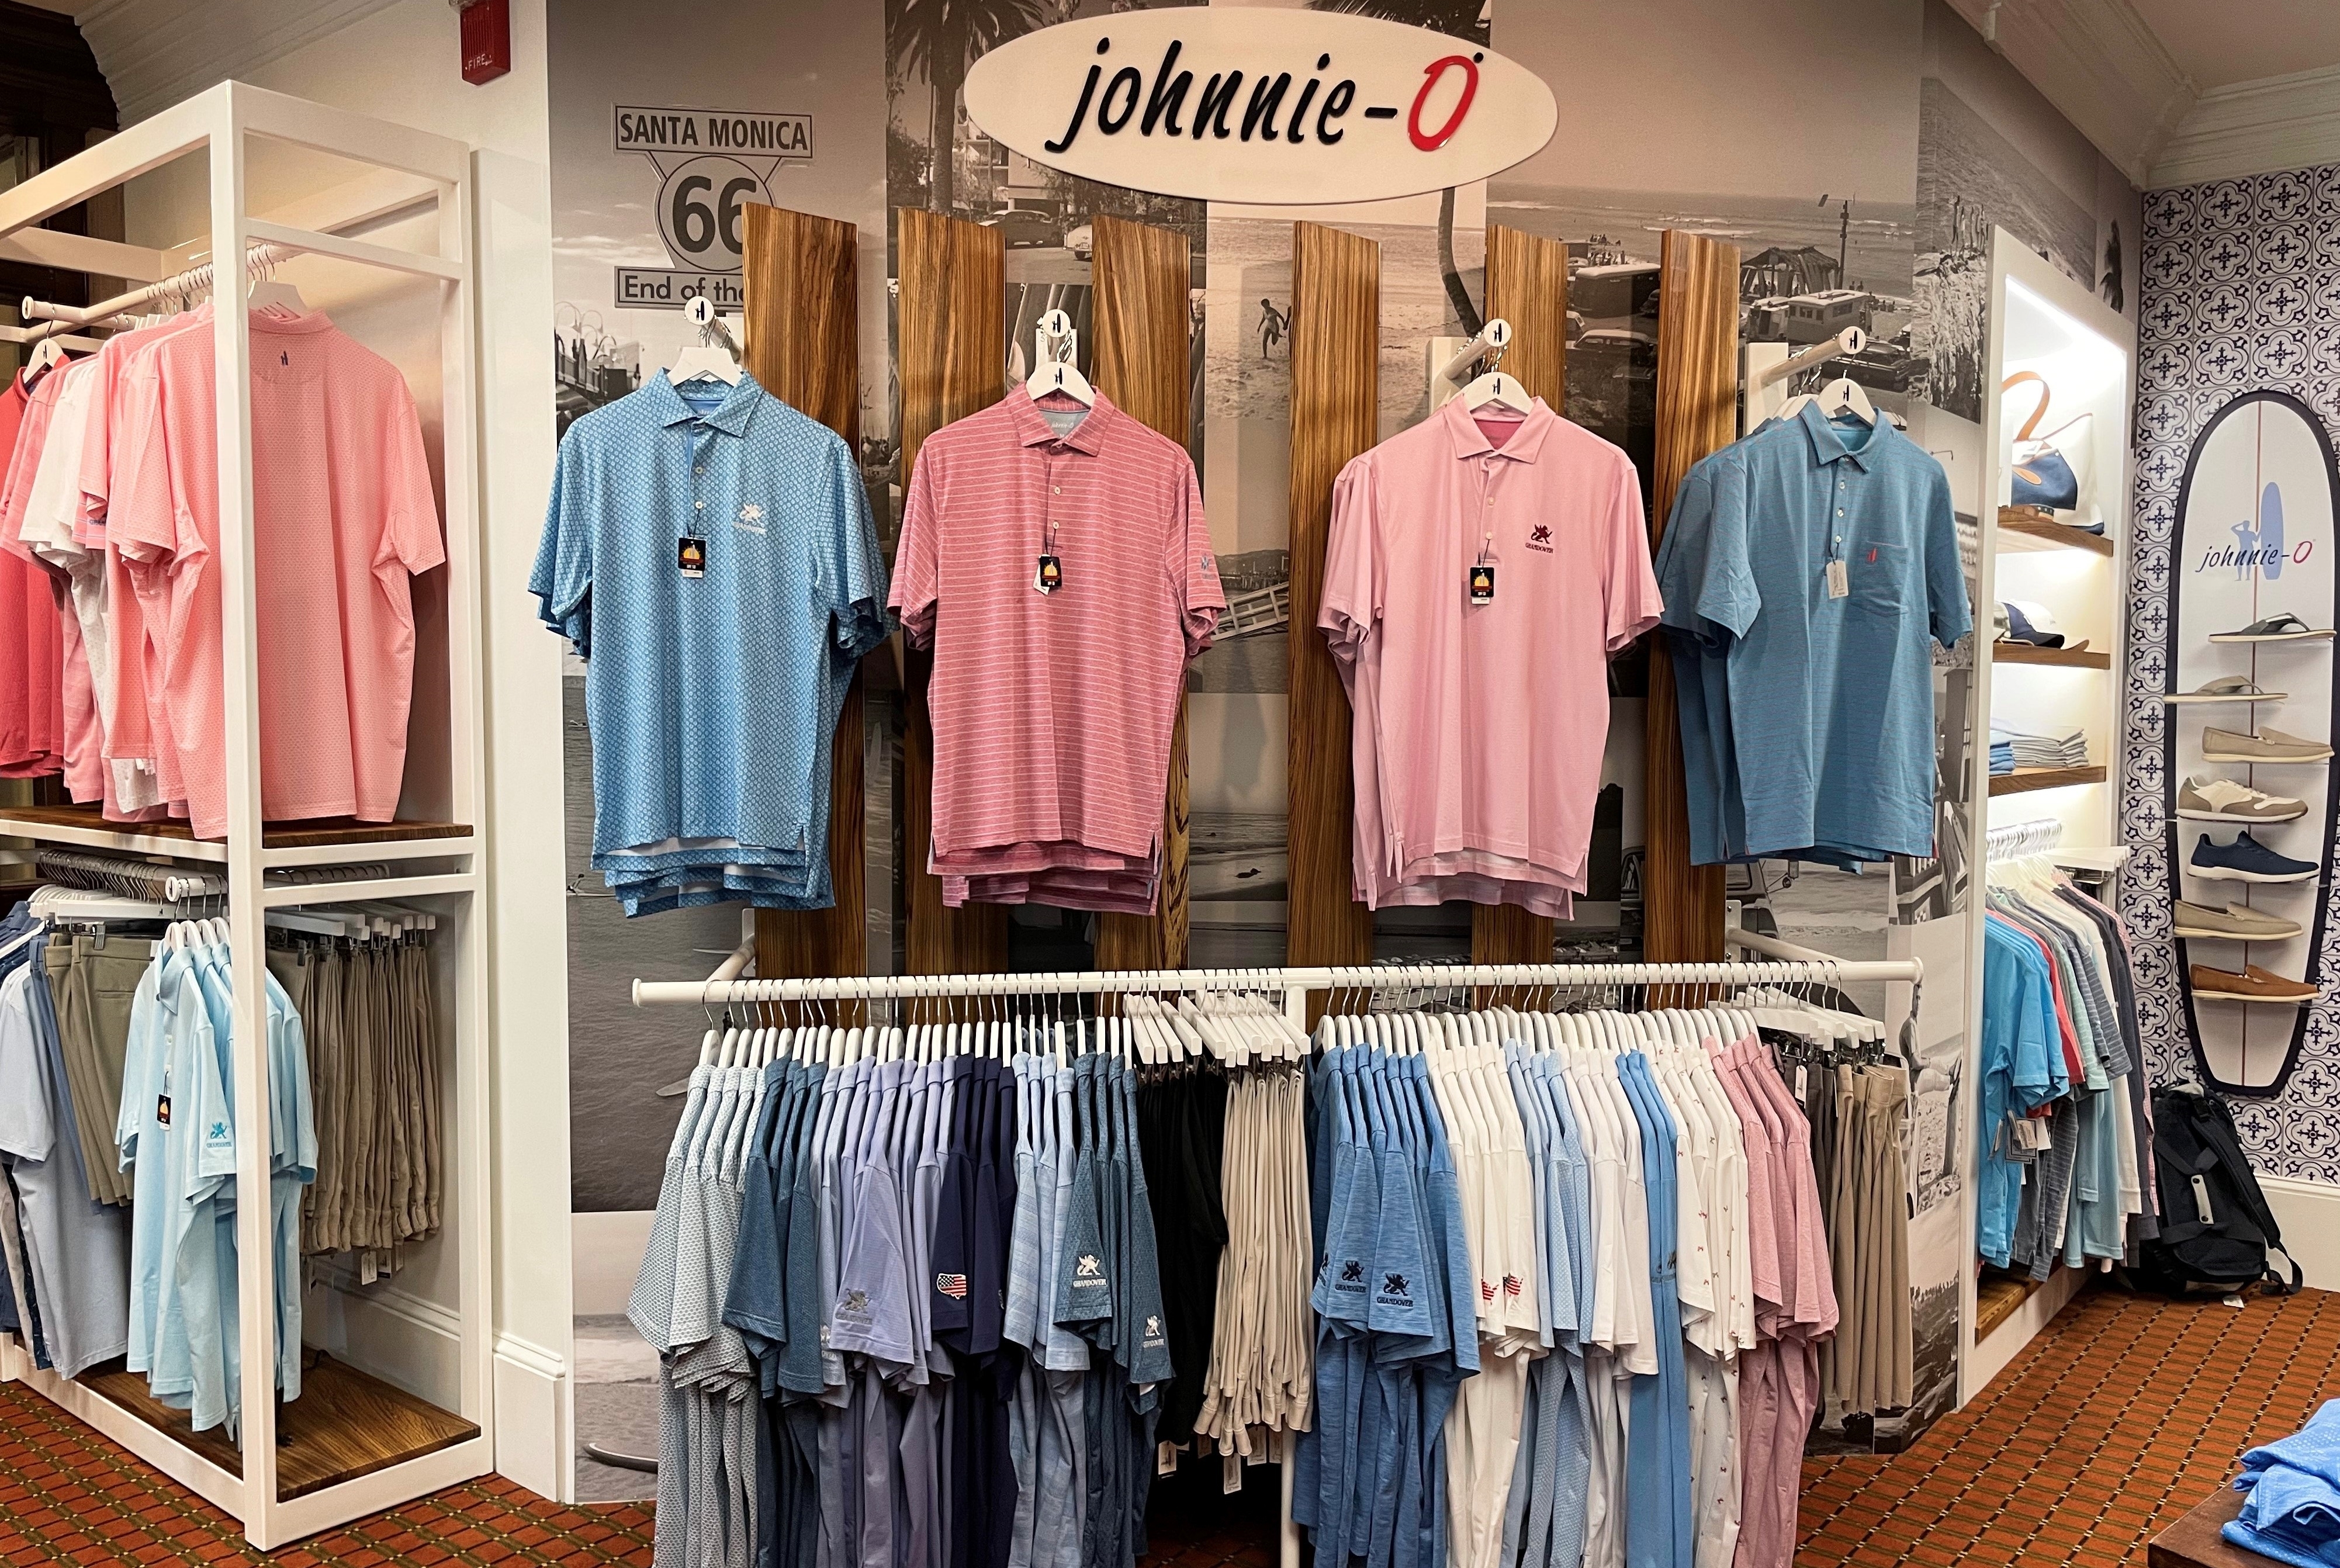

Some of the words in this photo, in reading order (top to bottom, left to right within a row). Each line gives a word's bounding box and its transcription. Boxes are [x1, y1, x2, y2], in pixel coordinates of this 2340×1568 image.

[468, 53, 486, 71] FIRE
[1044, 37, 1479, 153] johnnie-O
[620, 113, 699, 146] SANTA
[709, 118, 808, 151] MONICA
[672, 175, 757, 255] 66
[624, 275, 671, 299] End
[680, 276, 706, 300] of
[1525, 542, 1553, 553] GRANDOVER
[2194, 541, 2313, 573] johnnie-O
[1072, 1278, 1107, 1287] GRANDOVER
[1376, 1296, 1414, 1307] GRANDOVER
